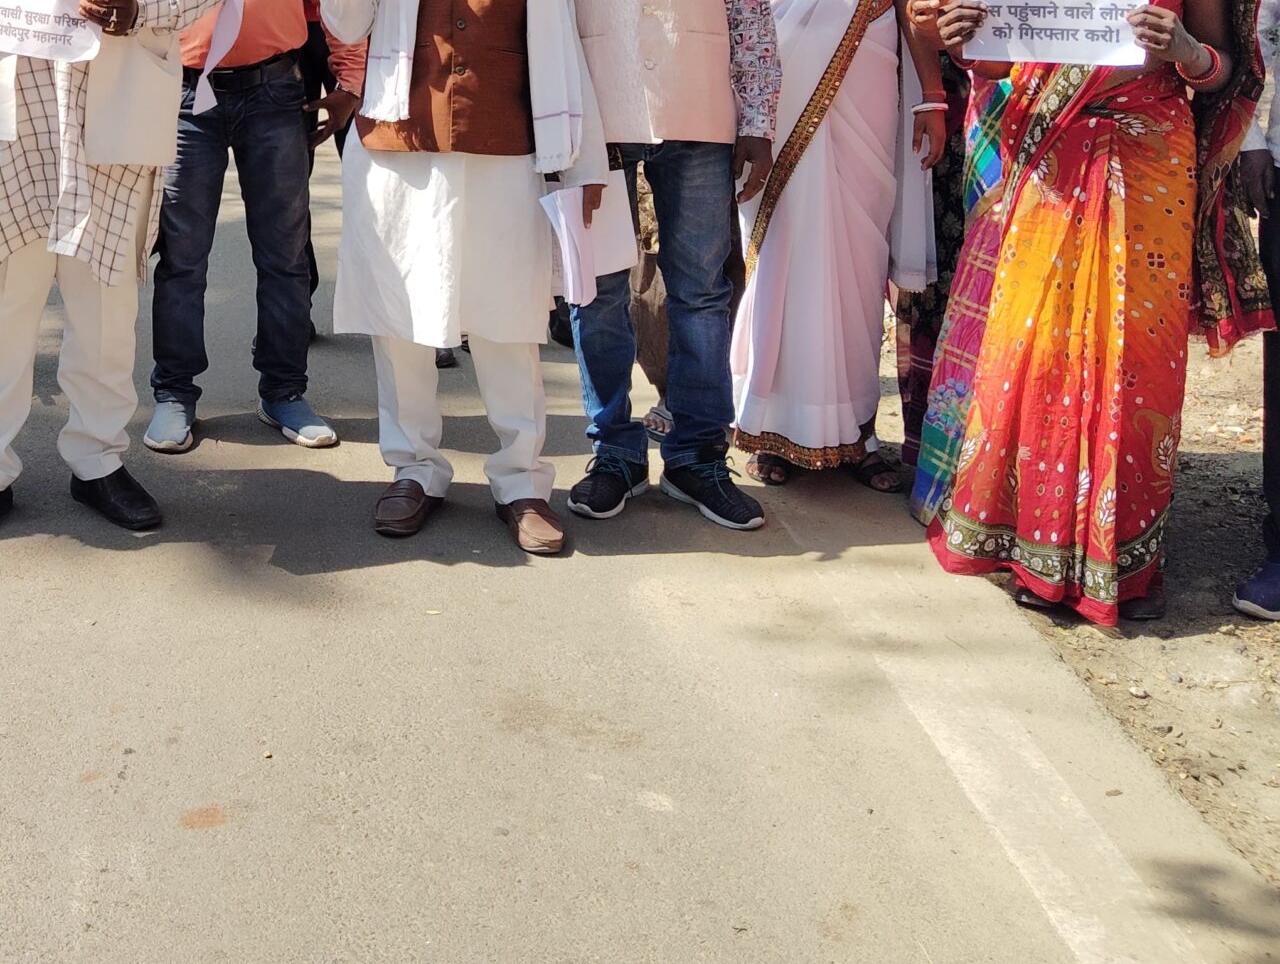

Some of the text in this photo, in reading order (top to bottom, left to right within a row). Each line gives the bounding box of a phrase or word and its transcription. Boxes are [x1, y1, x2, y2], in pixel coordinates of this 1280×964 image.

[25, 10, 51, 25] सुरक्षा
[53, 13, 88, 29] परिषद
[1006, 1, 1059, 22] पहुंचाने
[1064, 2, 1095, 20] वाले
[32, 29, 73, 46] महानगर
[992, 23, 1013, 40] को
